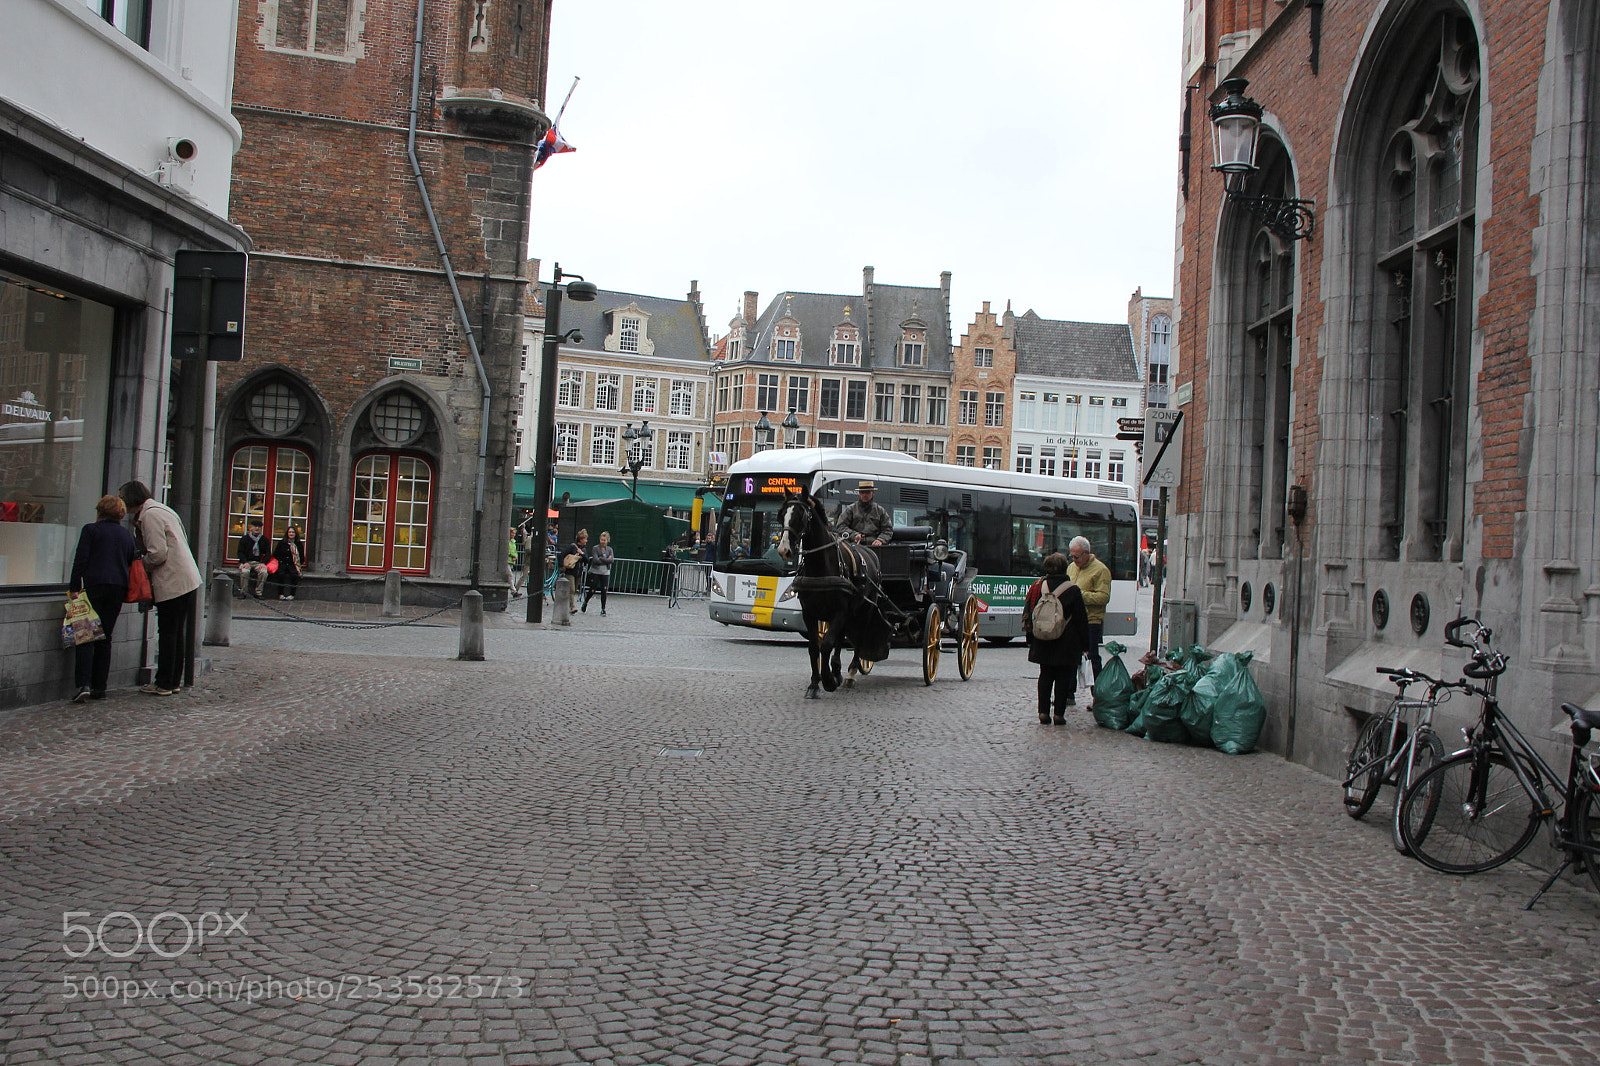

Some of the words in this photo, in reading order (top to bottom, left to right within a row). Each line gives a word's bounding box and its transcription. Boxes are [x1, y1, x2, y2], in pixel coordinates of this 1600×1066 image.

[5, 404, 52, 421] DELVAUX
[1152, 411, 1178, 420] ZONE
[1046, 436, 1054, 444] in
[1057, 437, 1067, 445] de
[1069, 437, 1099, 447] Klokke
[745, 477, 754, 494] 16
[767, 477, 796, 486] CENTRUM
[993, 584, 1018, 595] #SHOP
